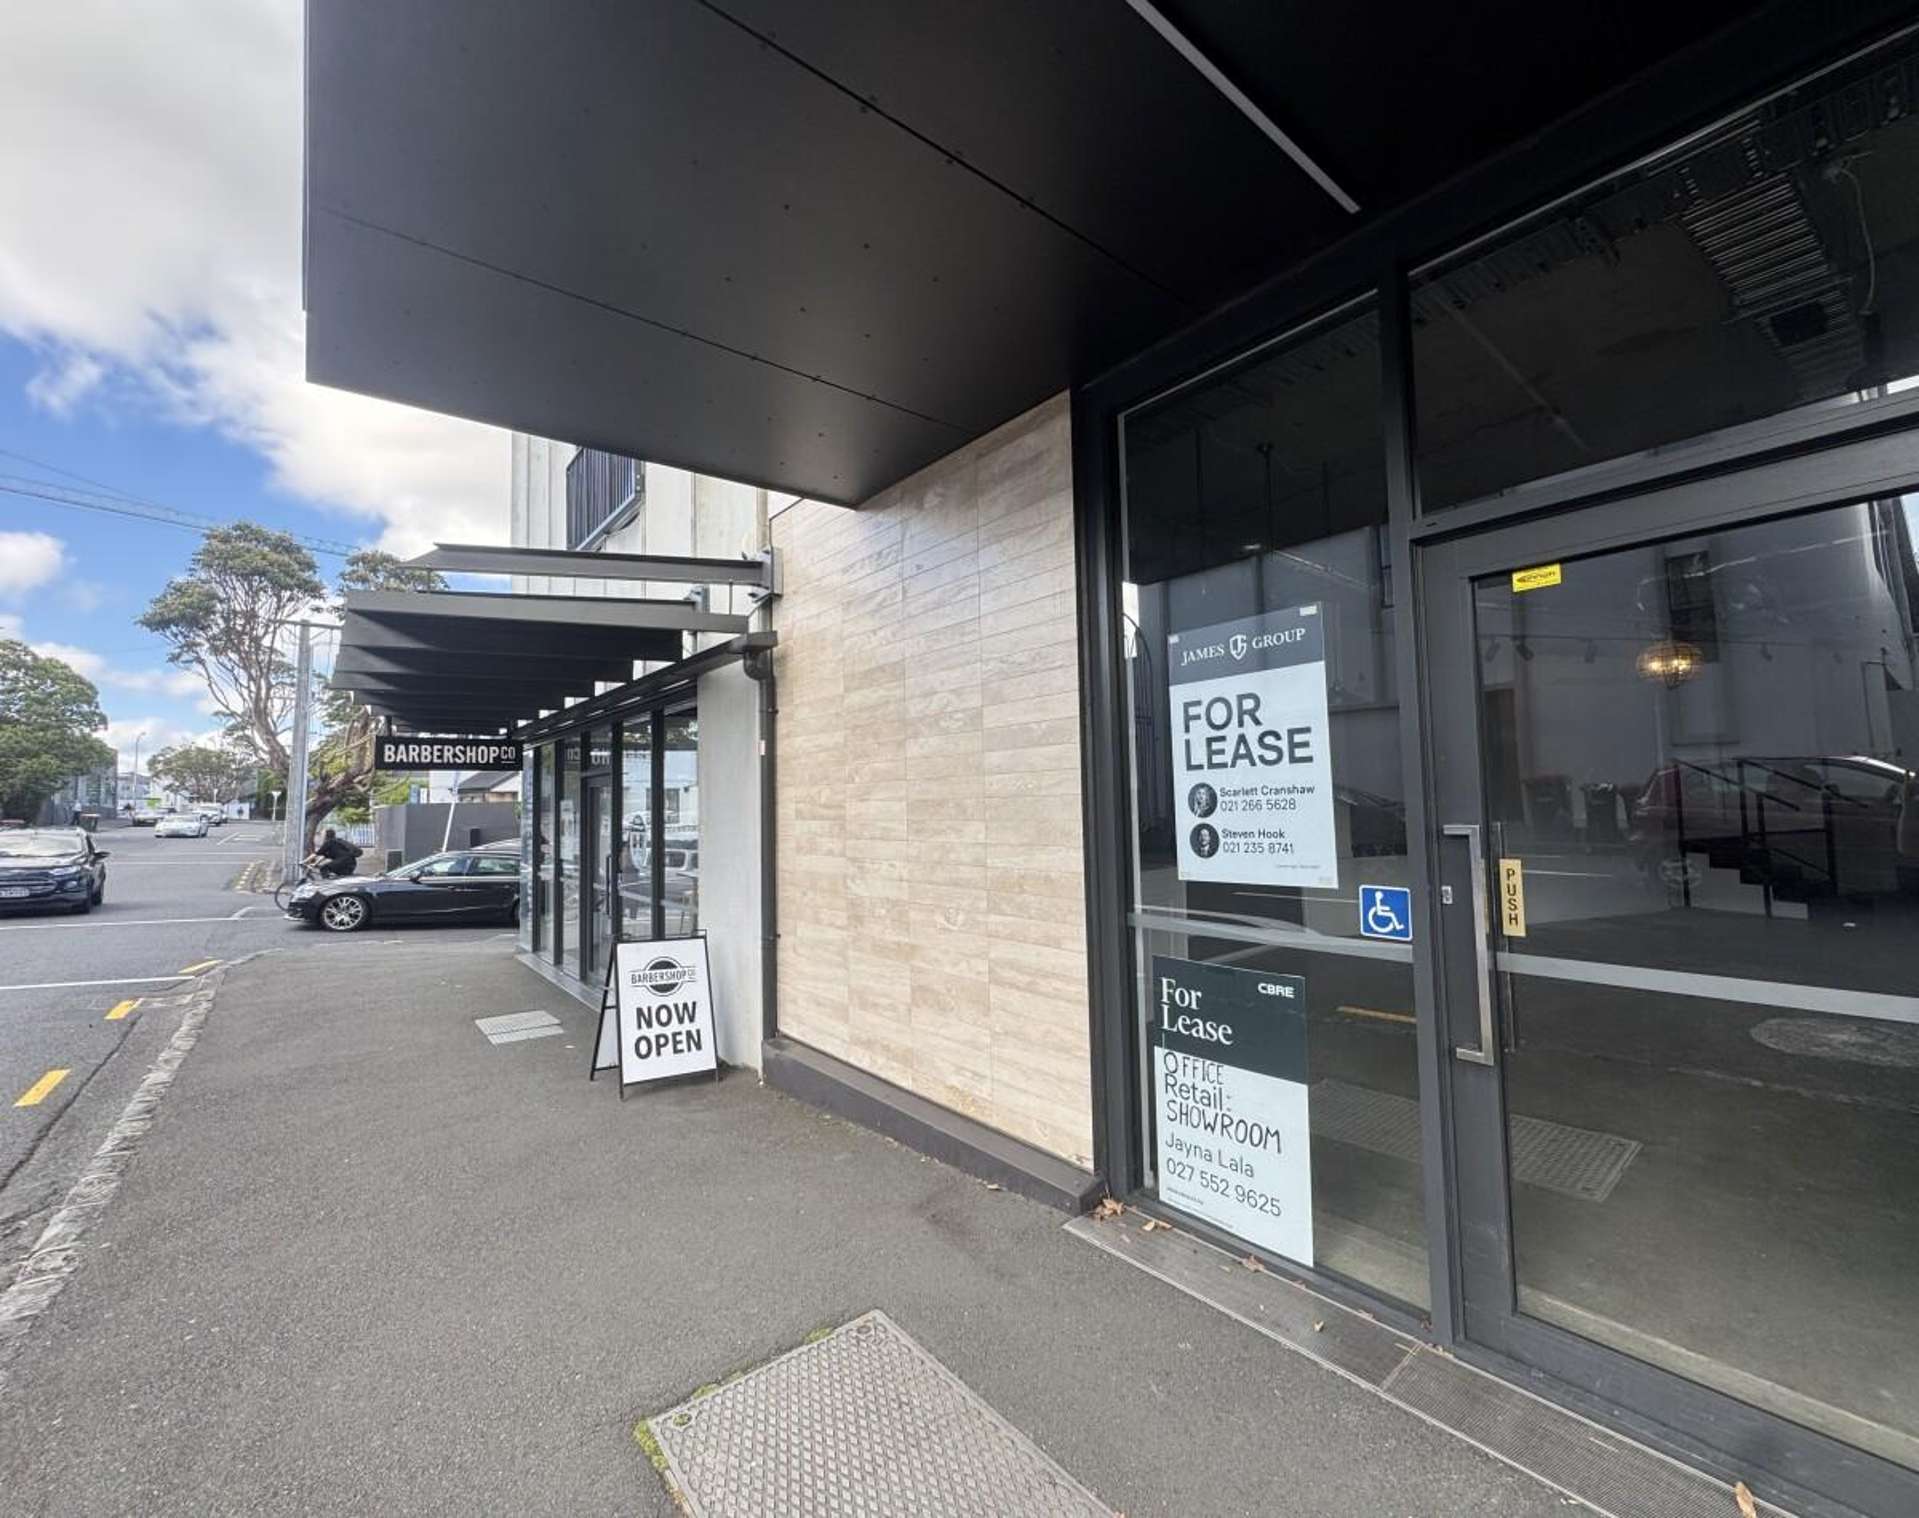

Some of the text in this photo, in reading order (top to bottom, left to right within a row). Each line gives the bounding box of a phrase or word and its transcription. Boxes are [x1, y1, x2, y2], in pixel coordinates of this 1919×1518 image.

[1180, 643, 1225, 666] JAMES
[1252, 627, 1306, 649] GROUP
[1183, 692, 1263, 734] FOR
[383, 744, 500, 764] BARBERSHOP
[1184, 726, 1314, 771] LEASE
[1220, 784, 1315, 798] Scarlett Cranshaw
[1220, 800, 1239, 812] 021
[1266, 798, 1296, 811] 5628
[1221, 828, 1285, 839] Steven Hook
[1222, 842, 1240, 853] 021
[1243, 842, 1265, 854] 235
[1506, 868, 1518, 927] PUSH
[631, 969, 687, 984] BARBERSHOP
[1257, 982, 1295, 999] CBRE
[1160, 977, 1202, 1010] For
[636, 1001, 697, 1030] NOW
[1160, 1004, 1234, 1045] Lease
[634, 1029, 702, 1060] OPEN
[1164, 1051, 1225, 1086] OFFICE
[1167, 1100, 1281, 1154] SHOWROOM
[1165, 1132, 1255, 1178] Jayna Lala
[1166, 1157, 1195, 1182] 027
[1200, 1170, 1230, 1198] 552
[1235, 1184, 1281, 1217] 9625
